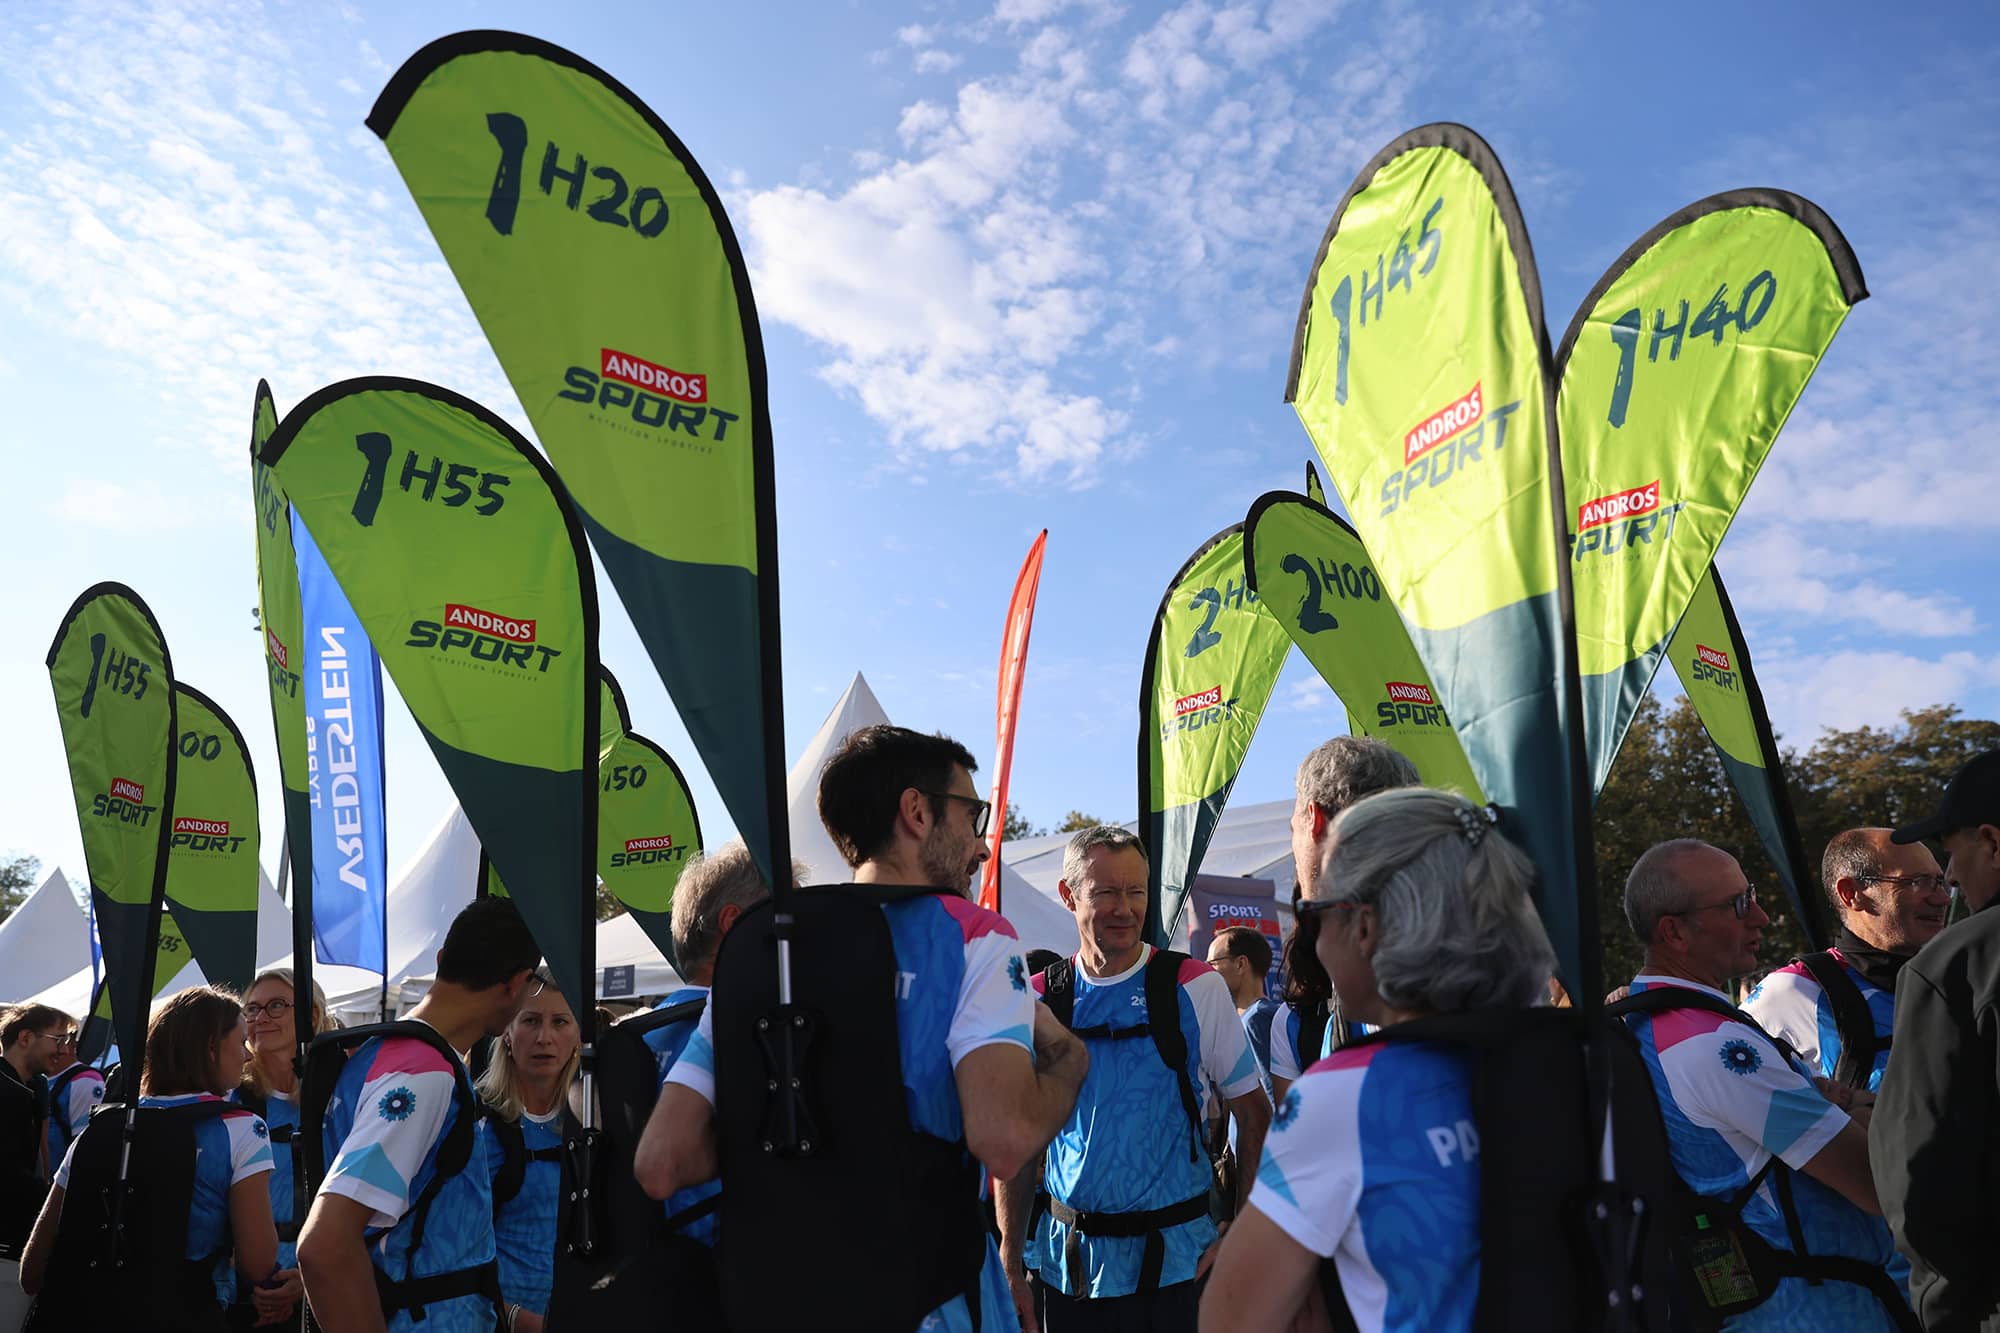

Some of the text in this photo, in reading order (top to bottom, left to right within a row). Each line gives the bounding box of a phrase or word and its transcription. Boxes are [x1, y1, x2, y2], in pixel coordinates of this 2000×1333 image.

[485, 112, 669, 238] 1H20
[1330, 197, 1444, 407] 1H45
[1607, 270, 1776, 429] 1H40
[605, 355, 701, 398] ANDROS
[558, 366, 739, 441] SPORT
[1407, 393, 1480, 459] ANDROS
[1380, 400, 1522, 518] SPORT
[351, 432, 511, 527] 1H55
[1582, 487, 1656, 526] ANDROS
[1280, 553, 1381, 634] 2H00
[449, 608, 532, 639] ANDROS
[1184, 574, 1260, 659] 2H
[405, 620, 561, 673] SPORT
[1699, 647, 1728, 668] ANDROS
[81, 633, 151, 719] 1H55
[1390, 685, 1431, 701] ANDROS
[1692, 659, 1739, 693] SPORT
[1175, 689, 1219, 714] ANDROS
[1377, 702, 1451, 727] SPORT
[113, 781, 142, 801] ANDROS
[92, 794, 157, 827] SPORT
[176, 820, 227, 834] ANDROS
[170, 833, 247, 853] PORT
[610, 846, 688, 868] SPORT
[628, 837, 670, 851] ANDROS
[1209, 904, 1262, 918] SPORTS
